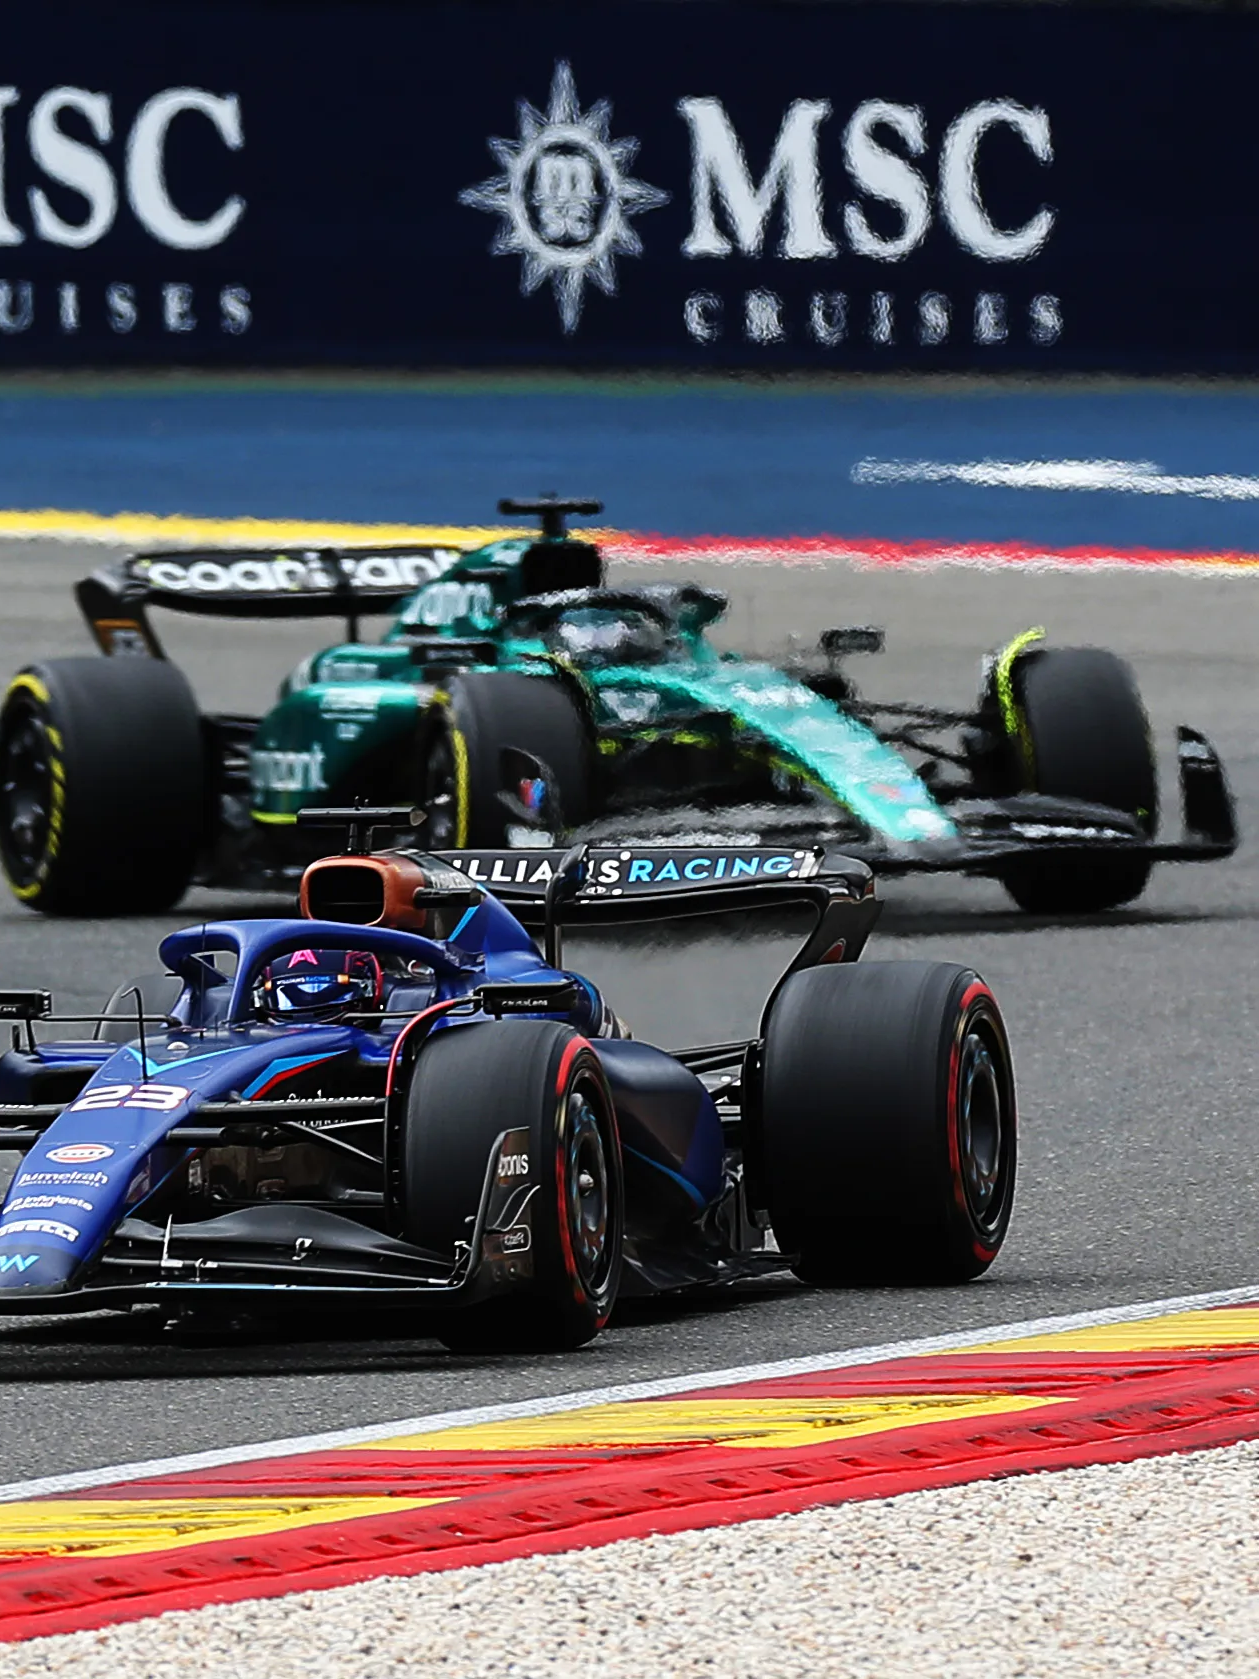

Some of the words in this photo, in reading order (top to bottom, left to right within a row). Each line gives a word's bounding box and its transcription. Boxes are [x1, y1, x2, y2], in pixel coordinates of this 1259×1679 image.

[677, 97, 1055, 263] MSC
[684, 289, 1063, 346] CRUISES
[627, 856, 793, 882] RACING
[70, 1084, 190, 1112] 23
